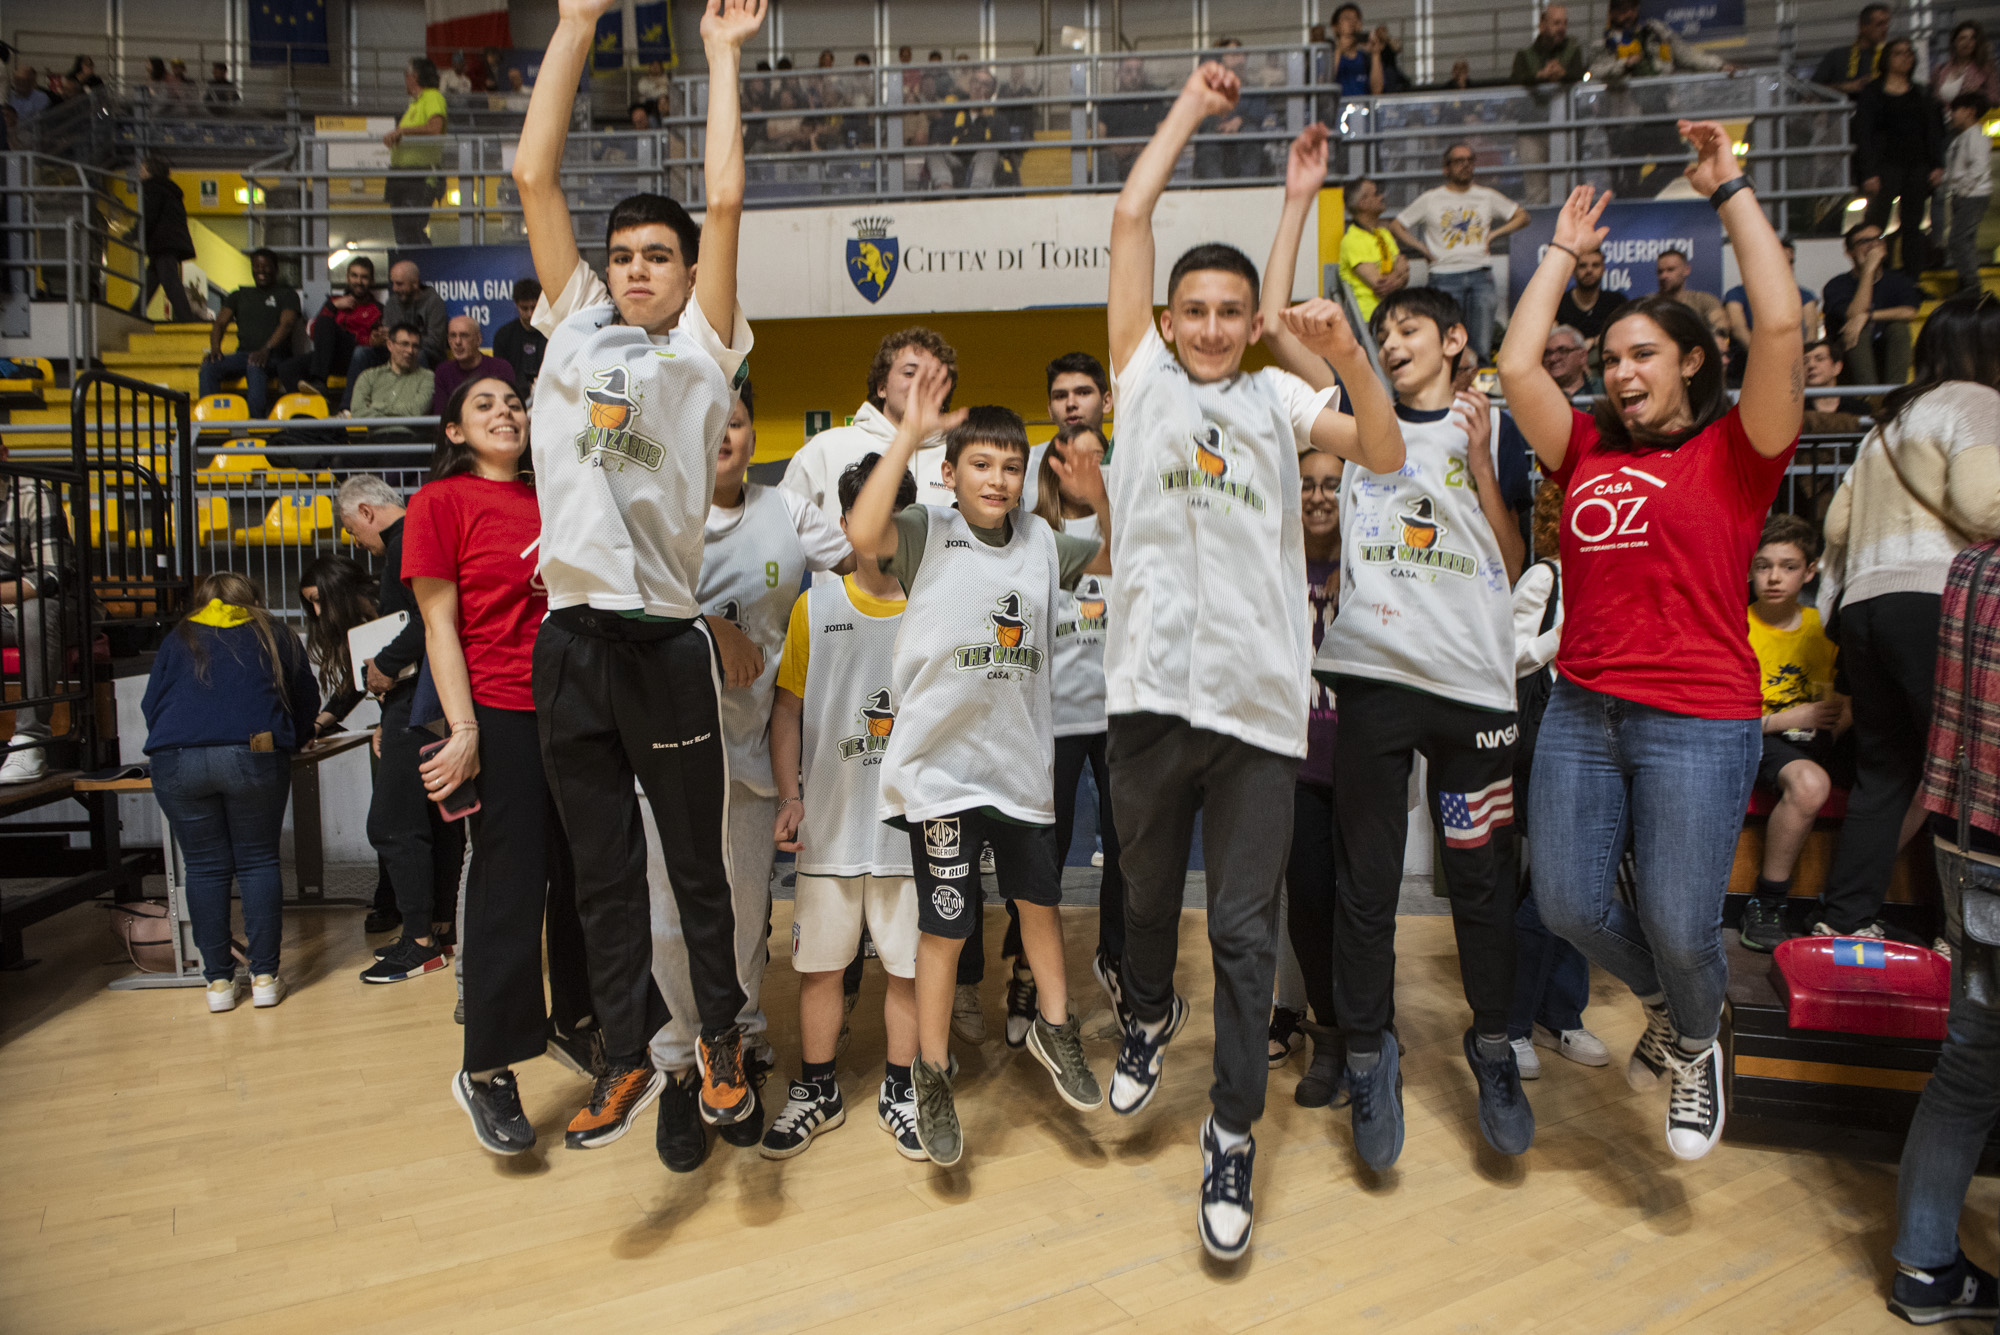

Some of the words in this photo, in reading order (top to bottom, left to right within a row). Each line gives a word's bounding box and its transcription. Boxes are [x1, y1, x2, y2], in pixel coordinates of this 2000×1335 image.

[1601, 268, 1632, 292] 104
[588, 427, 661, 467] WIZARDS
[1594, 481, 1633, 496] CASA
[1571, 496, 1649, 543] OZ
[1360, 545, 1392, 562] THE
[1398, 544, 1476, 577] WIZARDS
[765, 561, 779, 588] 9
[957, 646, 991, 669] THE
[1475, 722, 1520, 749] NASA
[948, 864, 969, 877] BLUE
[931, 892, 965, 910] CAUTION
[1852, 942, 1865, 965] 1
